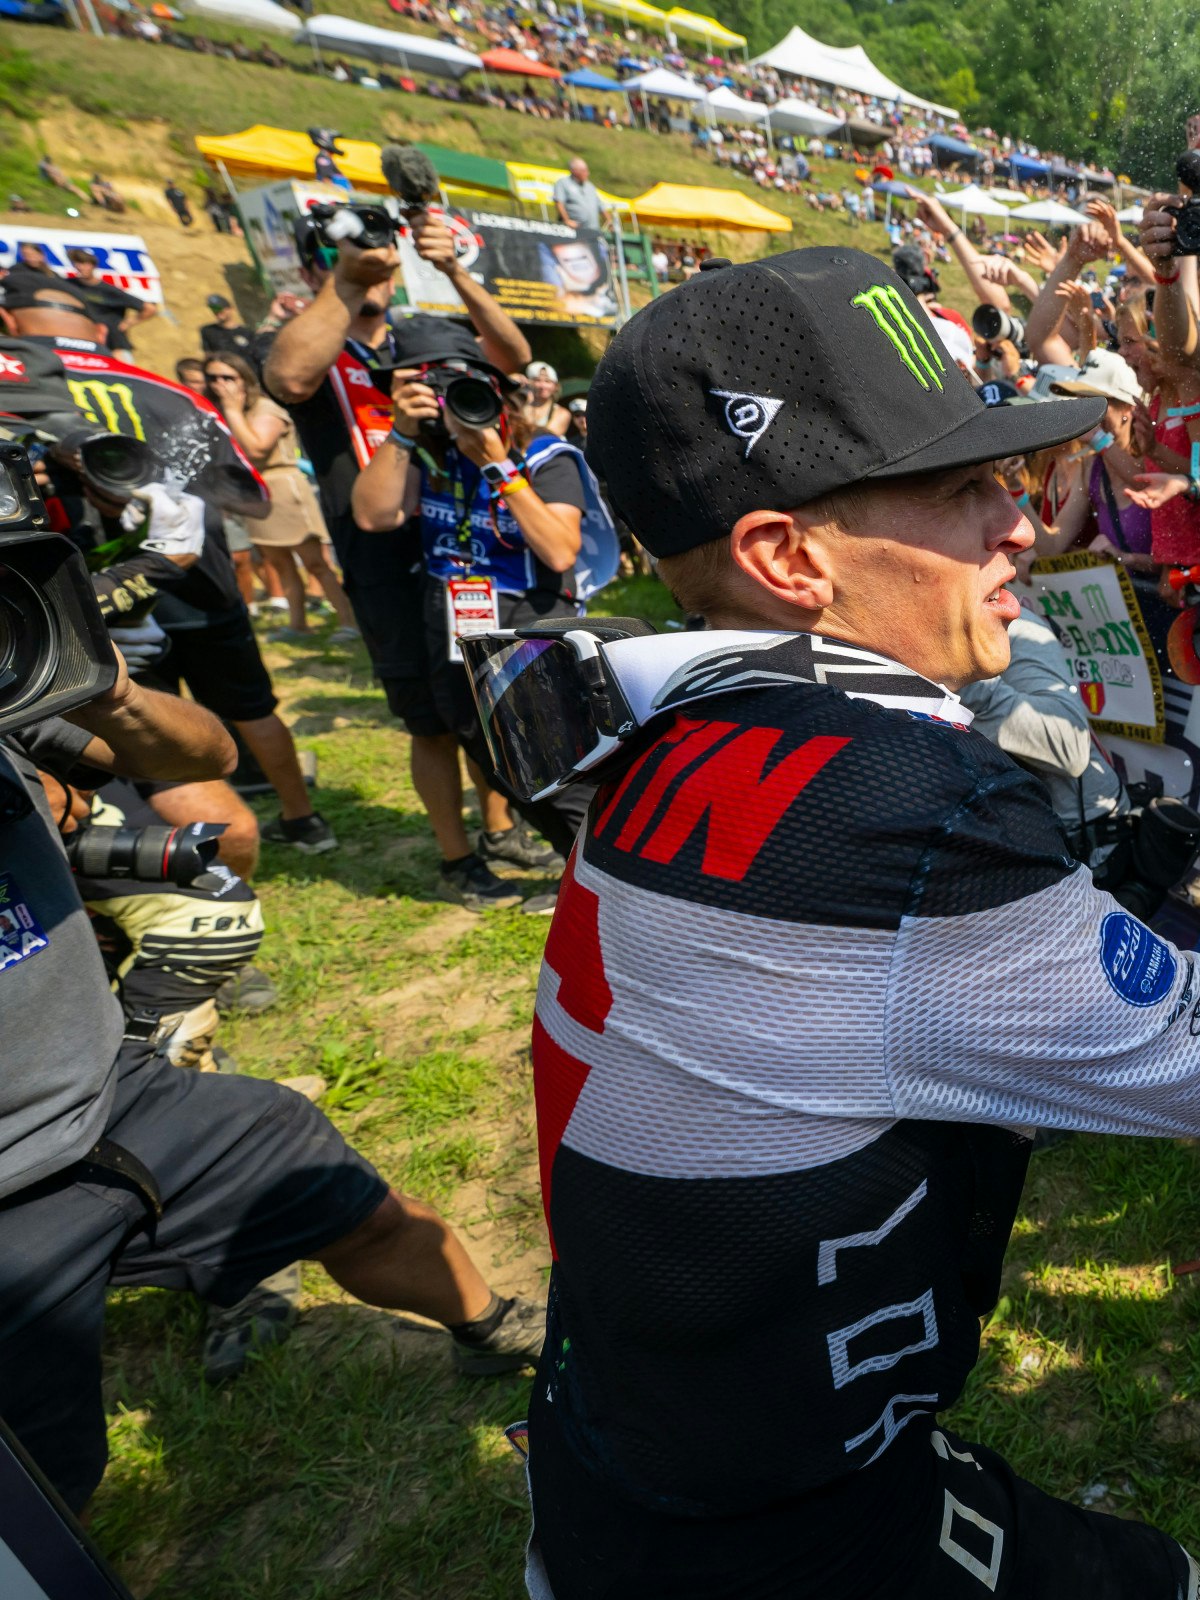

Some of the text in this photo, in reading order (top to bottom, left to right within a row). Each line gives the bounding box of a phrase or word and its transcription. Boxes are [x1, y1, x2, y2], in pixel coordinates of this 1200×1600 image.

[191, 915, 251, 932] FOX
[1112, 917, 1131, 977] BLU
[1120, 923, 1141, 981] CRU
[1146, 943, 1163, 981] YAMAHA
